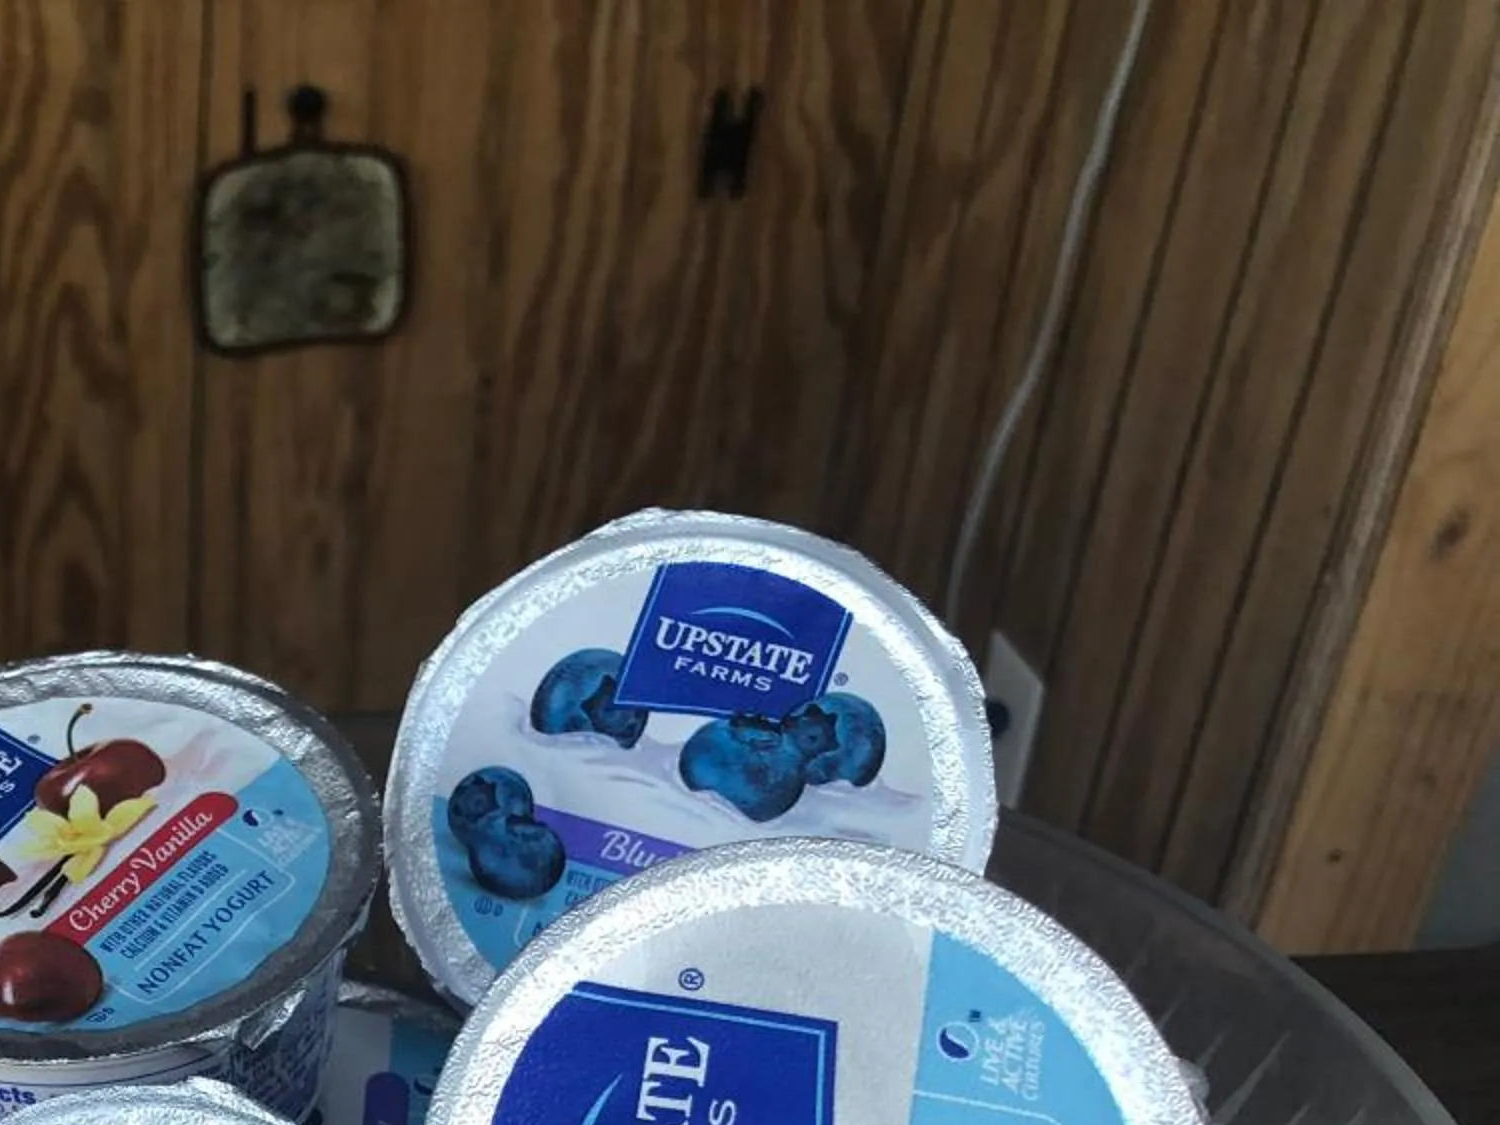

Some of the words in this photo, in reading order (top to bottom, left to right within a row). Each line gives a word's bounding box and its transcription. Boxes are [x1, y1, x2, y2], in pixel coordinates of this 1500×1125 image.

[655, 616, 814, 685] UPSTATE
[673, 655, 773, 692] FARMS
[69, 873, 141, 931] Cherry
[131, 811, 213, 870] Vanilla
[137, 930, 210, 995] NONFAT
[201, 870, 275, 934] YOGURT
